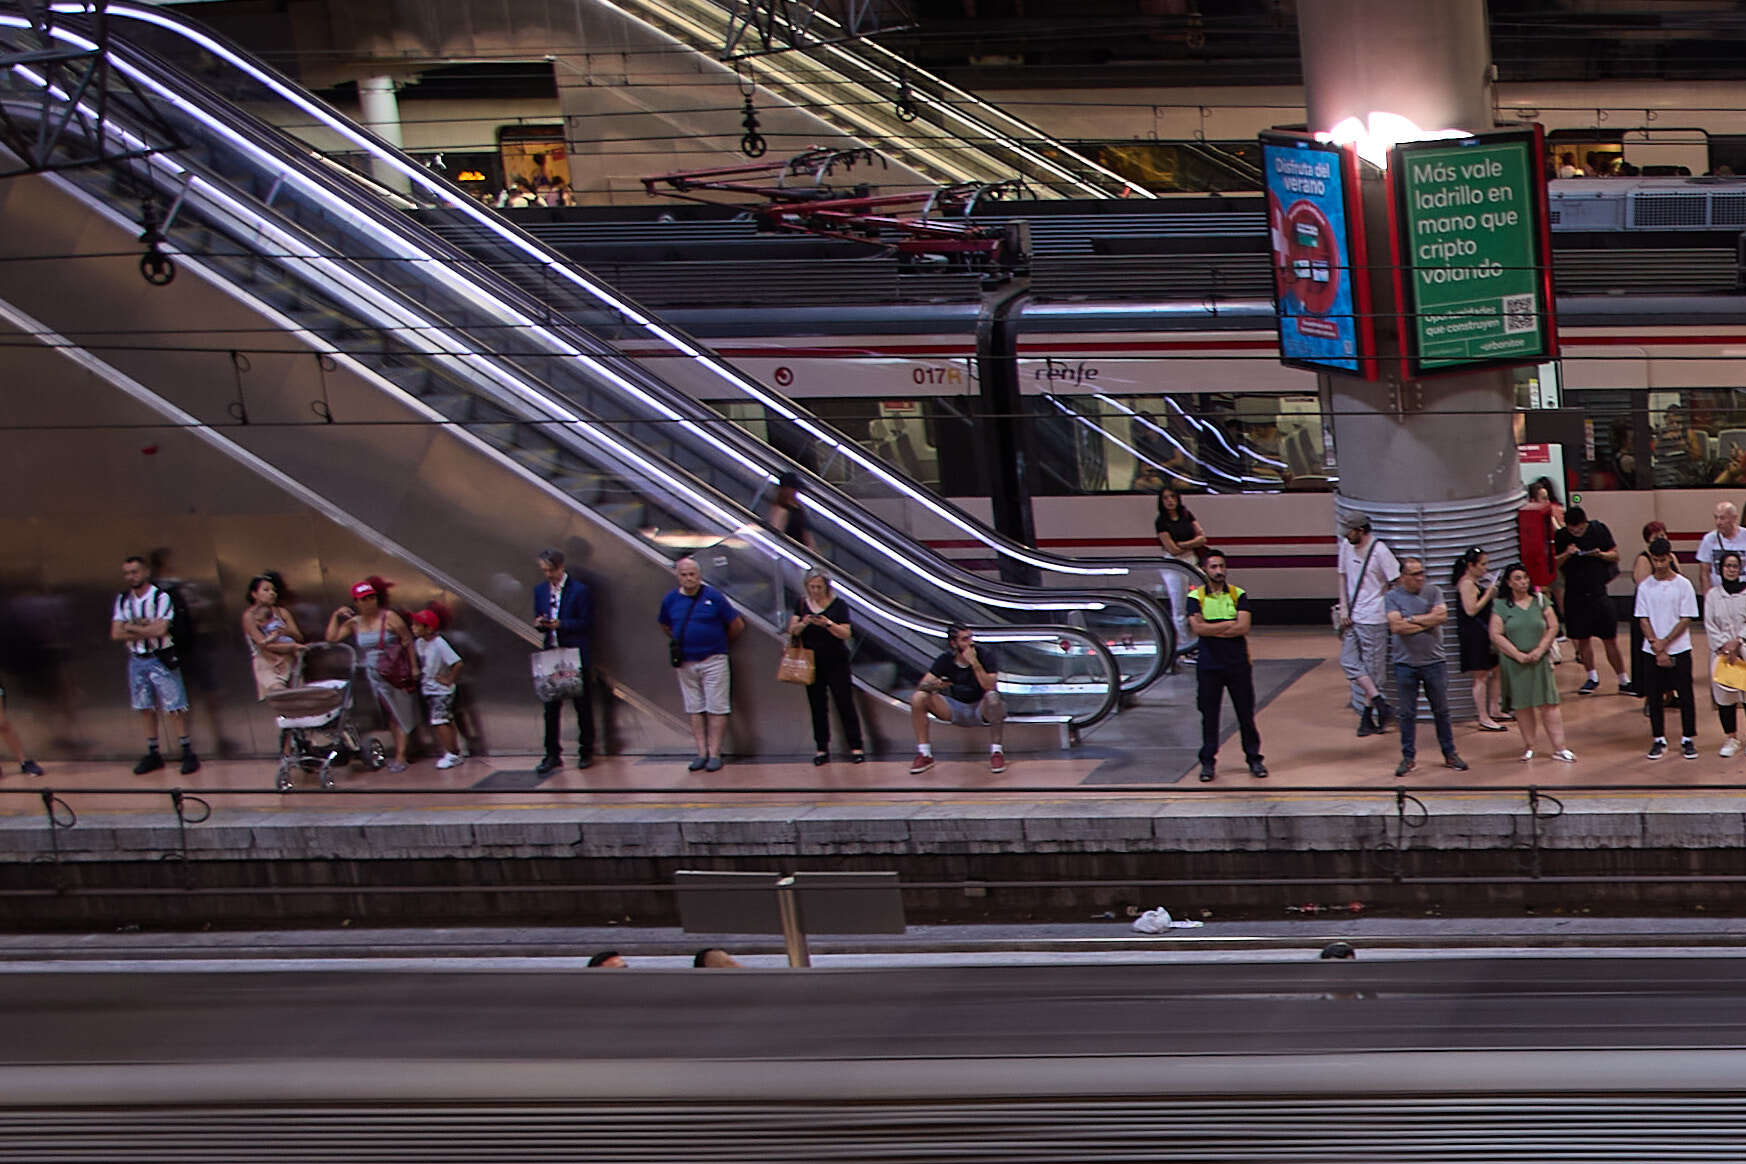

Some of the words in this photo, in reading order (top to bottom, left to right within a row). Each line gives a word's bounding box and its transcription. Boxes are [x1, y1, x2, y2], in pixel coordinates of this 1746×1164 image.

[1275, 157, 1314, 177] Disfruta
[1315, 162, 1331, 178] del
[1413, 162, 1457, 184] Más
[1461, 158, 1503, 180] vale
[1283, 176, 1326, 195] verano
[1415, 184, 1484, 210] ladrillo
[1488, 186, 1513, 203] en
[1417, 215, 1477, 235] mano
[1481, 210, 1519, 232] que
[1419, 238, 1478, 261] cripto
[1421, 258, 1504, 285] volando
[1425, 325, 1446, 337] que
[913, 367, 962, 385] 017R
[1035, 361, 1099, 388] renfe
